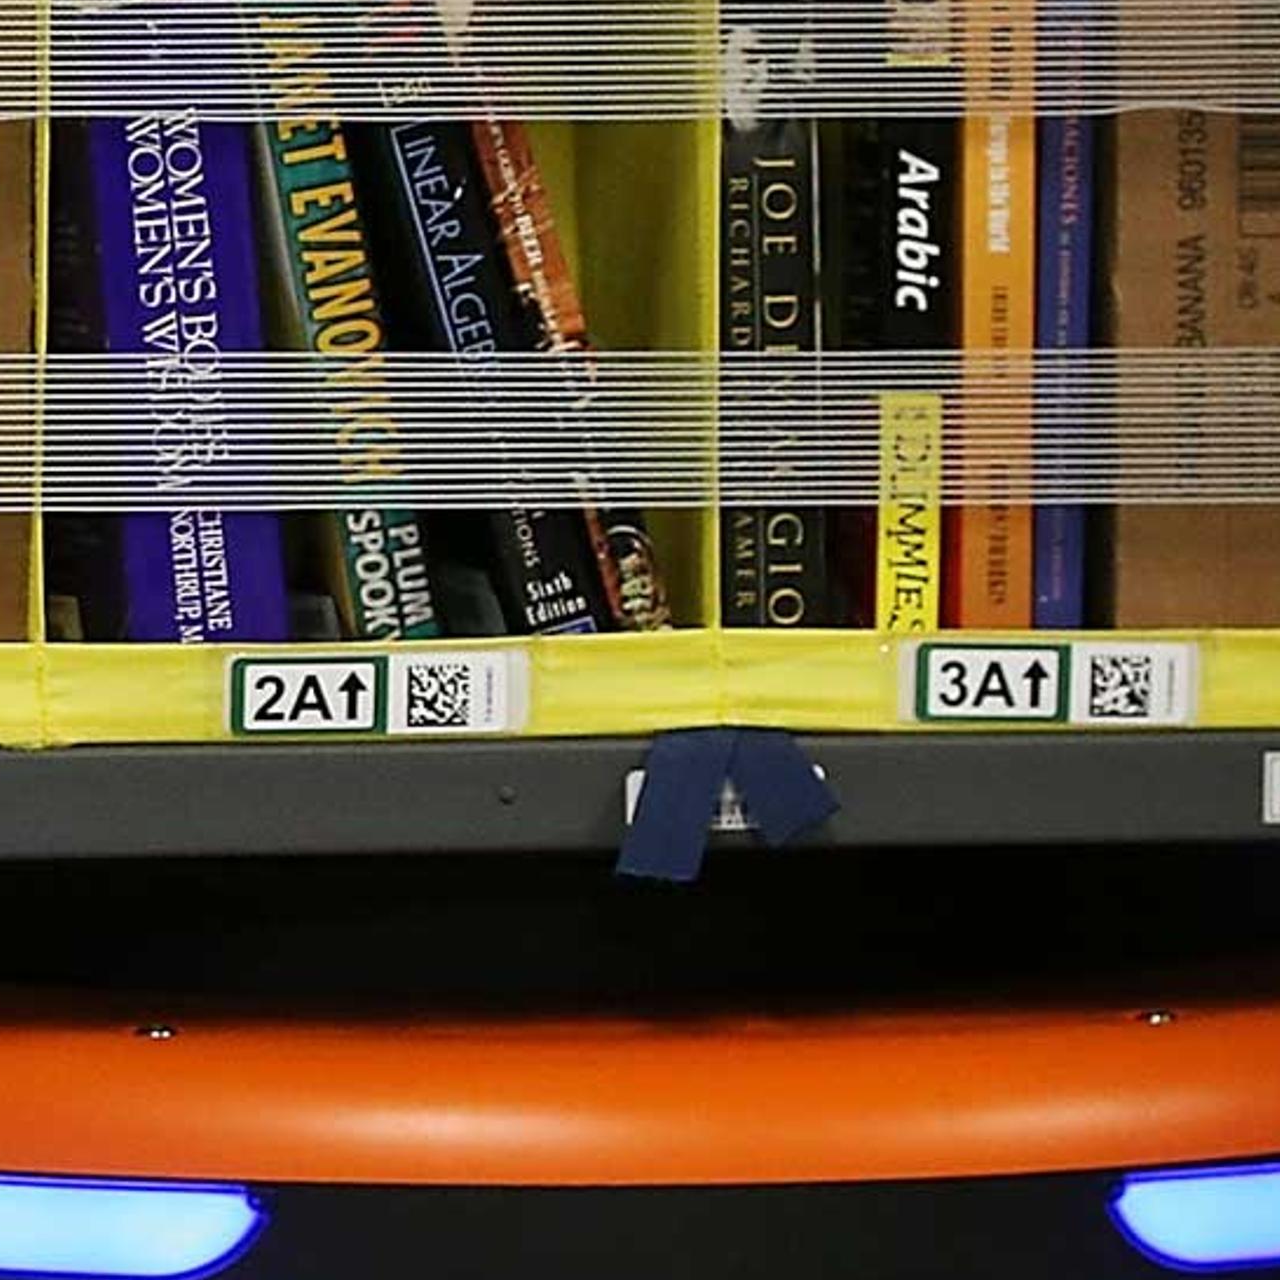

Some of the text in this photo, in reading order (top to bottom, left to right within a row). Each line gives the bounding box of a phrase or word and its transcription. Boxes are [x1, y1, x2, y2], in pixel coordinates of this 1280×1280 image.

[125, 112, 179, 309] WOMEN'S
[160, 107, 218, 305] WOMEN'S
[515, 212, 544, 268] BEER
[753, 157, 798, 256] JOE
[895, 148, 940, 313] Arabic
[728, 177, 753, 348] RICHARD
[196, 508, 233, 632] CHRISTIANE
[389, 522, 434, 626] PLUM
[524, 595, 588, 626] Edition
[526, 570, 573, 602] Sixth
[253, 675, 334, 721] 2A
[940, 660, 1015, 708] 3A
